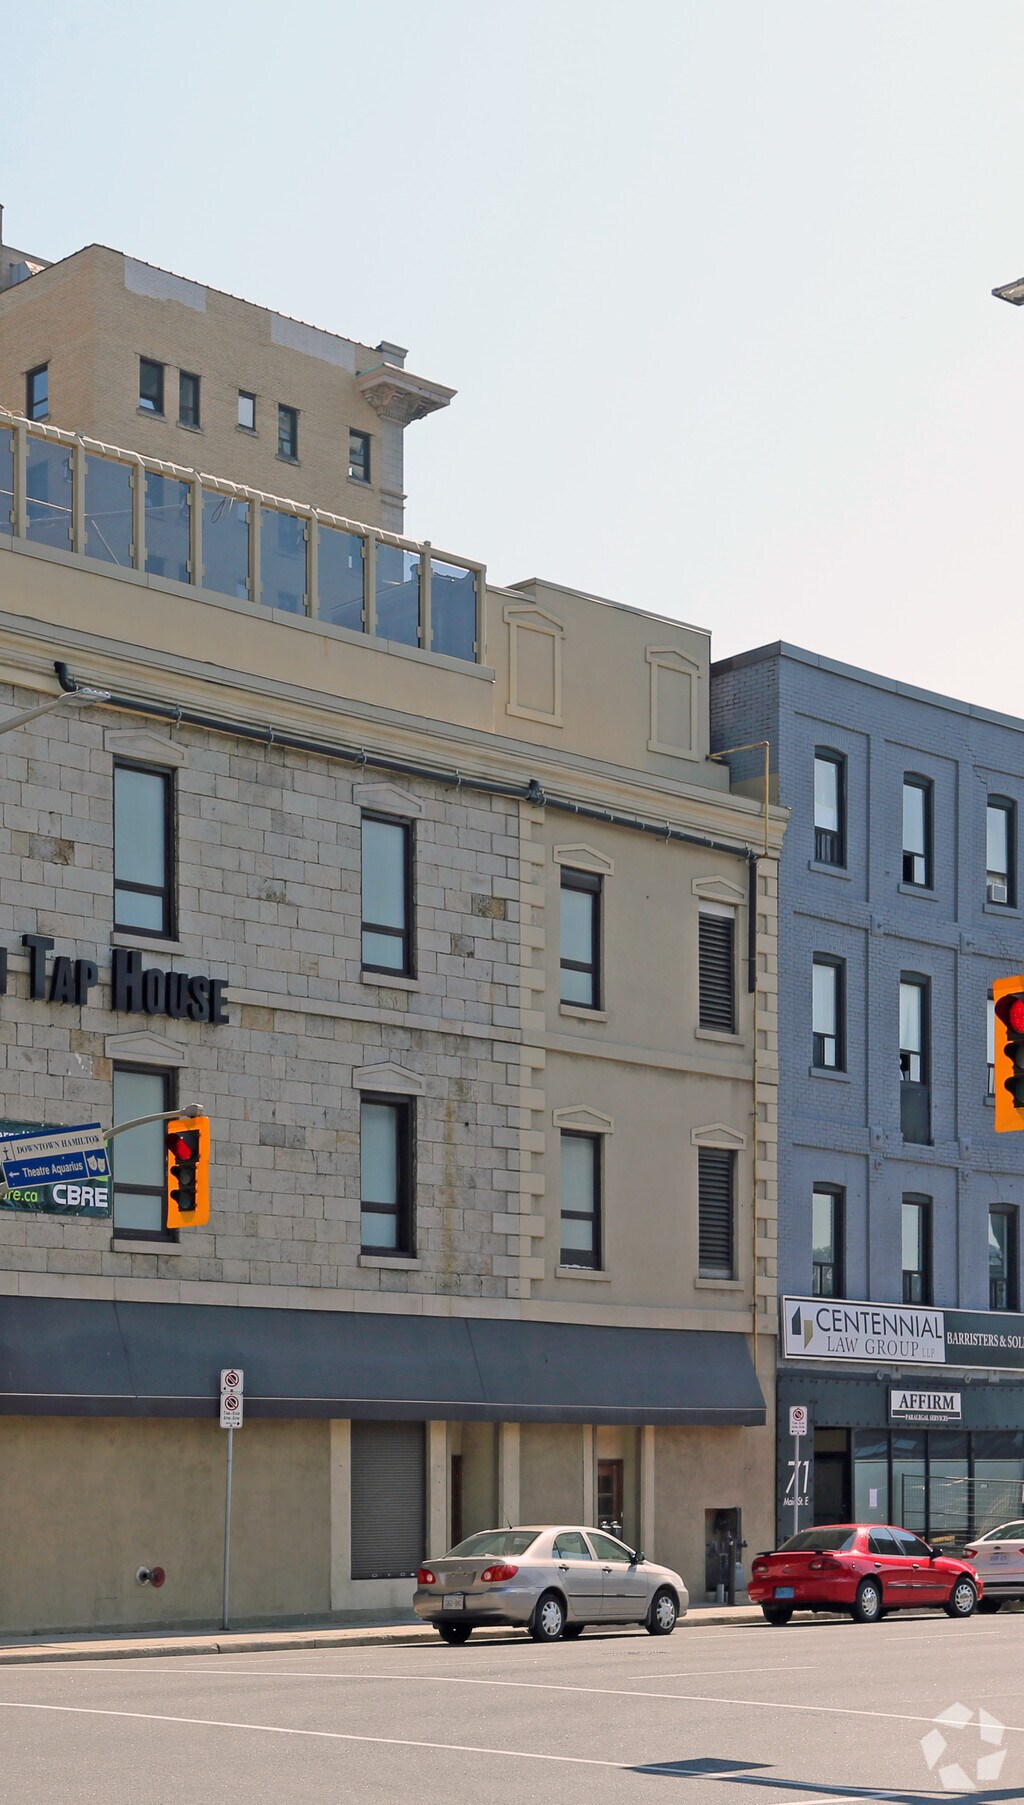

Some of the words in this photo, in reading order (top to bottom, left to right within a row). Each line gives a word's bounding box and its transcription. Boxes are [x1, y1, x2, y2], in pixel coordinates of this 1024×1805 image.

[22, 934, 98, 1006] TAP
[111, 948, 230, 1025] HOUSE
[16, 1139, 61, 1154] DOWNTOWN
[61, 1134, 100, 1148] HAMILTON
[22, 1165, 50, 1178] Theatre
[51, 1160, 84, 1176] Aquarius
[52, 1184, 109, 1208] CBRE
[815, 1307, 943, 1339] CENTENNIAL
[826, 1336, 859, 1354] LAW
[865, 1338, 920, 1357] GROUP
[921, 1348, 936, 1359] LLP
[946, 1331, 999, 1347] BARRISTERS
[999, 1334, 1007, 1348] &
[899, 1393, 955, 1410] AFFIRM
[785, 1460, 810, 1494] 71
